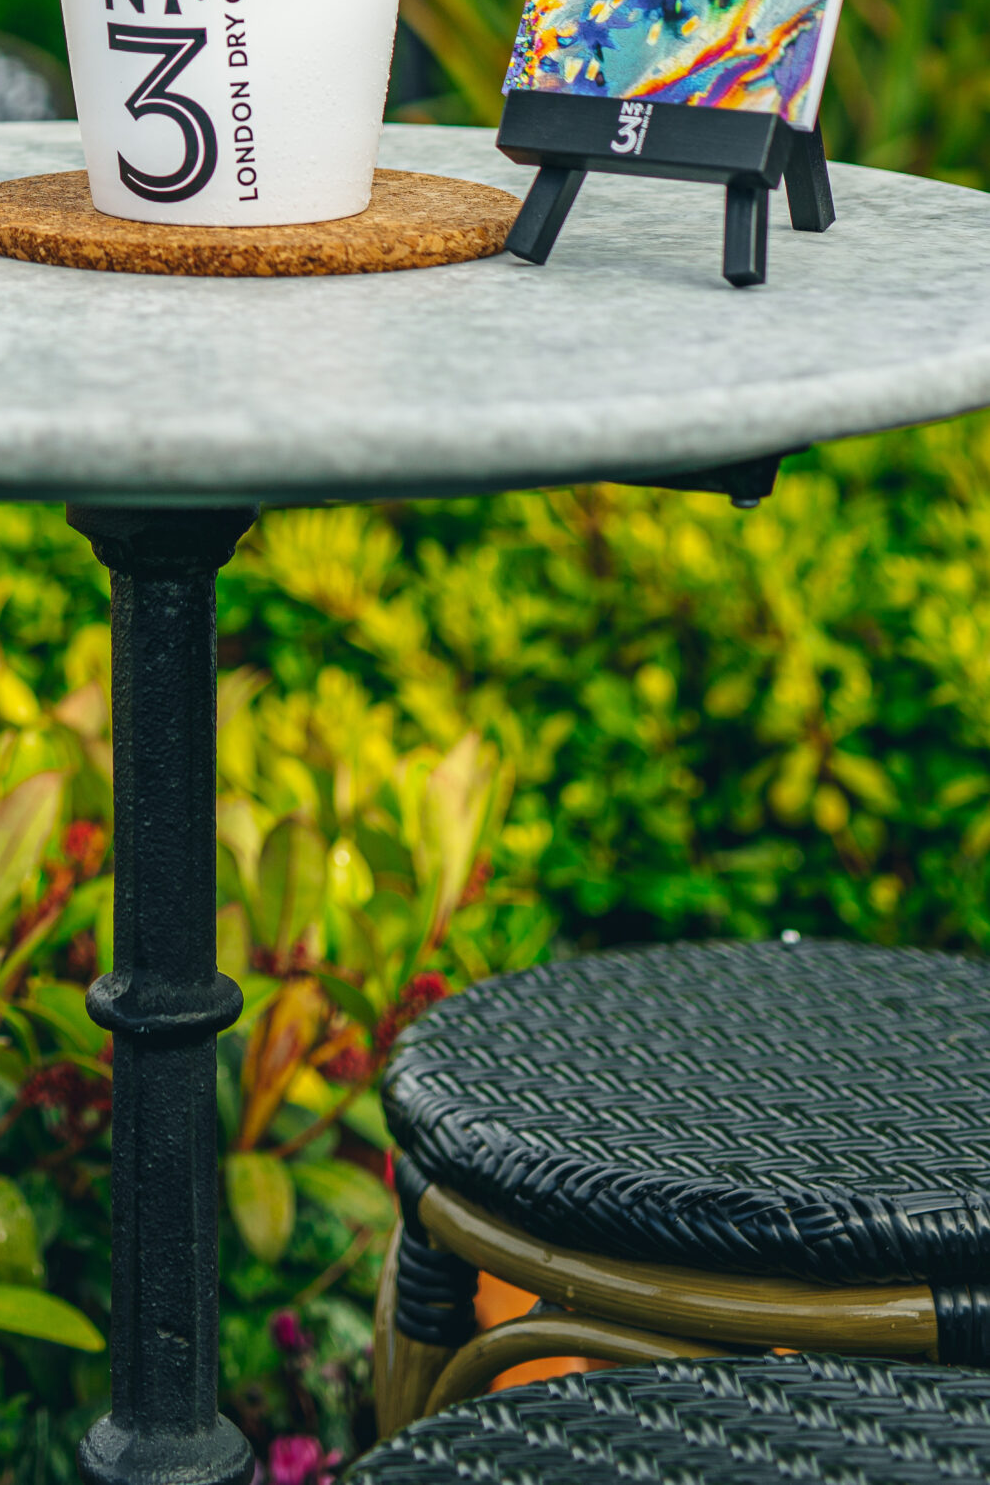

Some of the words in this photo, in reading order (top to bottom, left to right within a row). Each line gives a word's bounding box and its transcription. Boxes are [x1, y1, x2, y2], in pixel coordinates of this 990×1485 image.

[224, 13, 249, 68] DRY
[106, 21, 218, 203] 3
[230, 81, 259, 202] LONDON
[610, 114, 643, 154] 3
